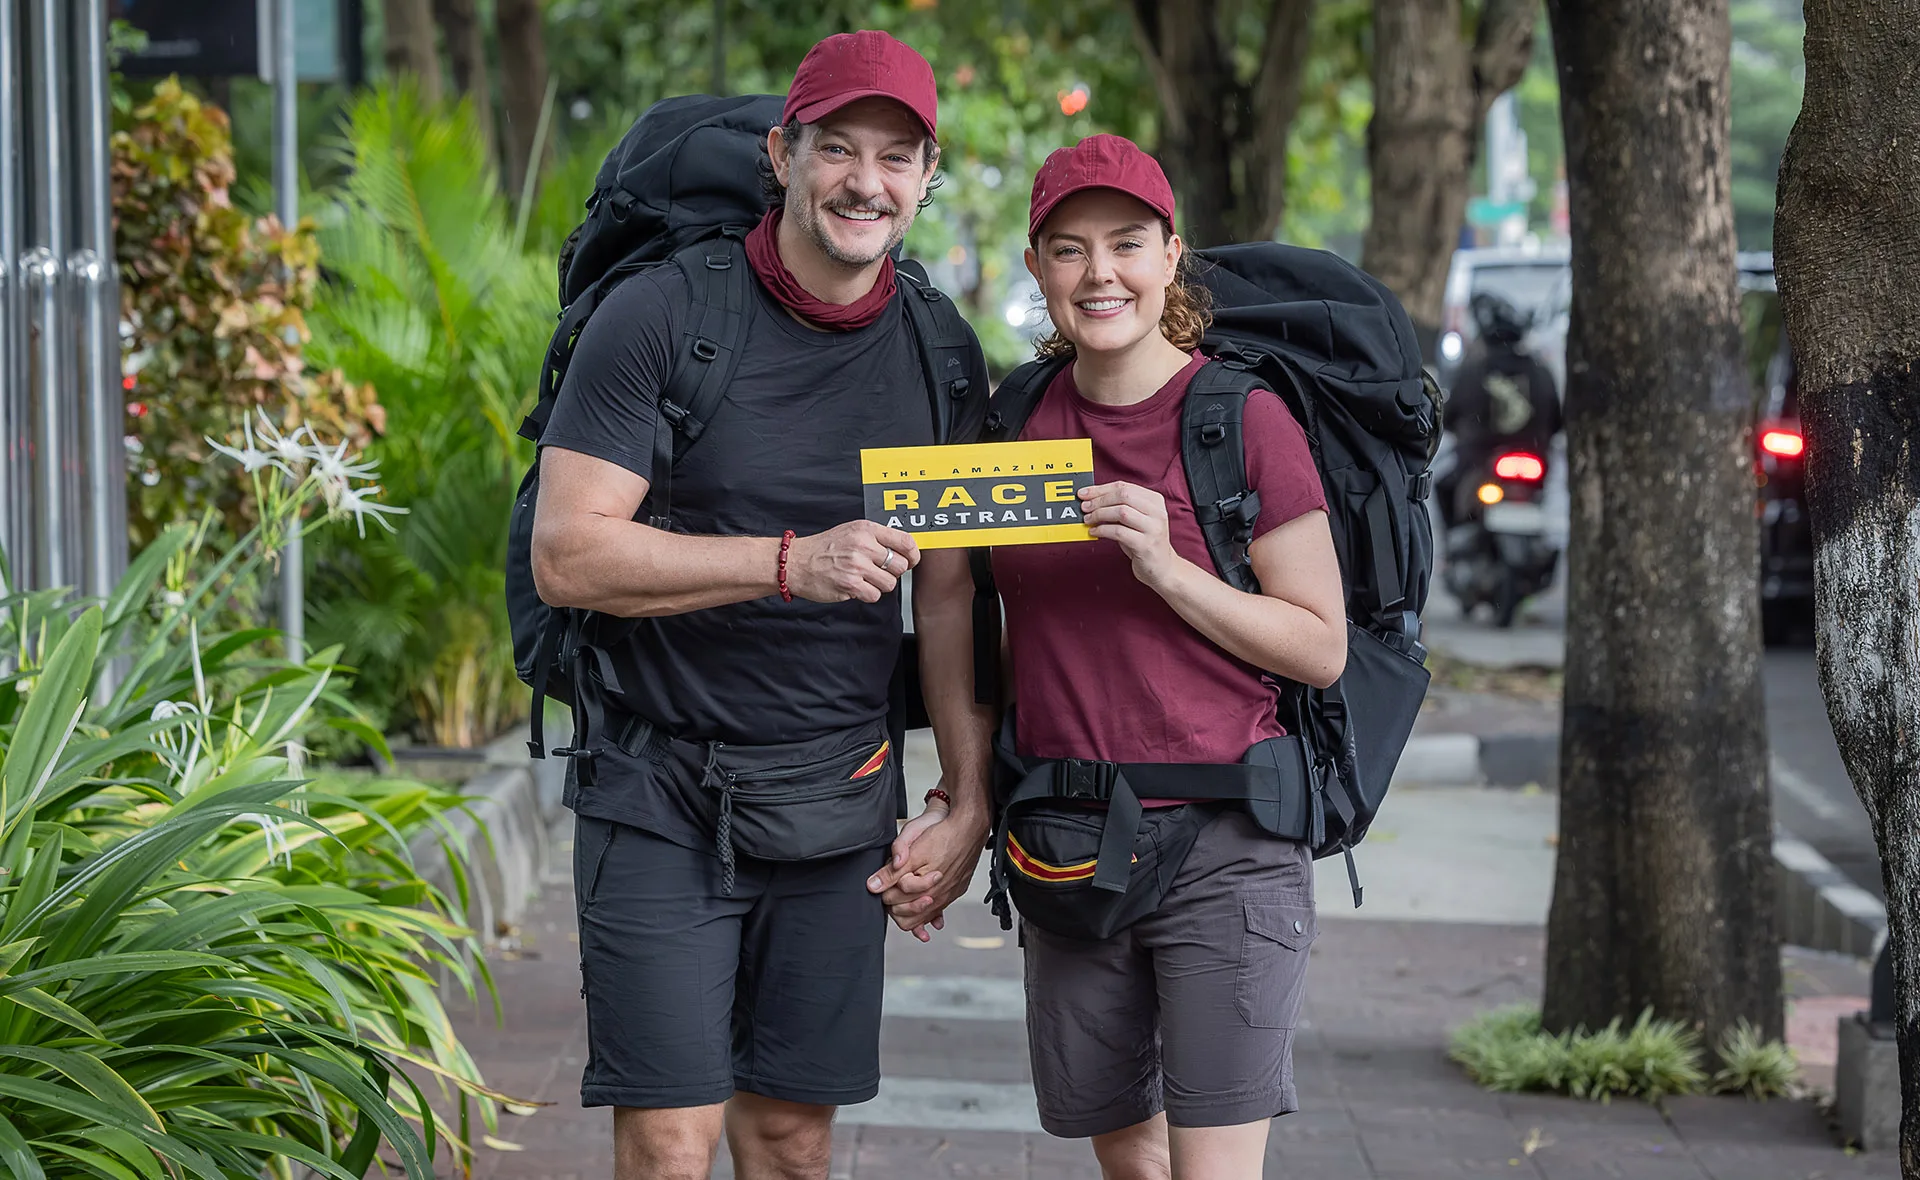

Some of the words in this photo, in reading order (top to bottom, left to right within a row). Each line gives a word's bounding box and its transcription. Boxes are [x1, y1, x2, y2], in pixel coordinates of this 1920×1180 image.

[882, 469, 926, 478] THE
[952, 462, 1075, 474] AMAZING
[883, 480, 1076, 511] RACE
[886, 506, 1078, 528] AUSTRALIA
